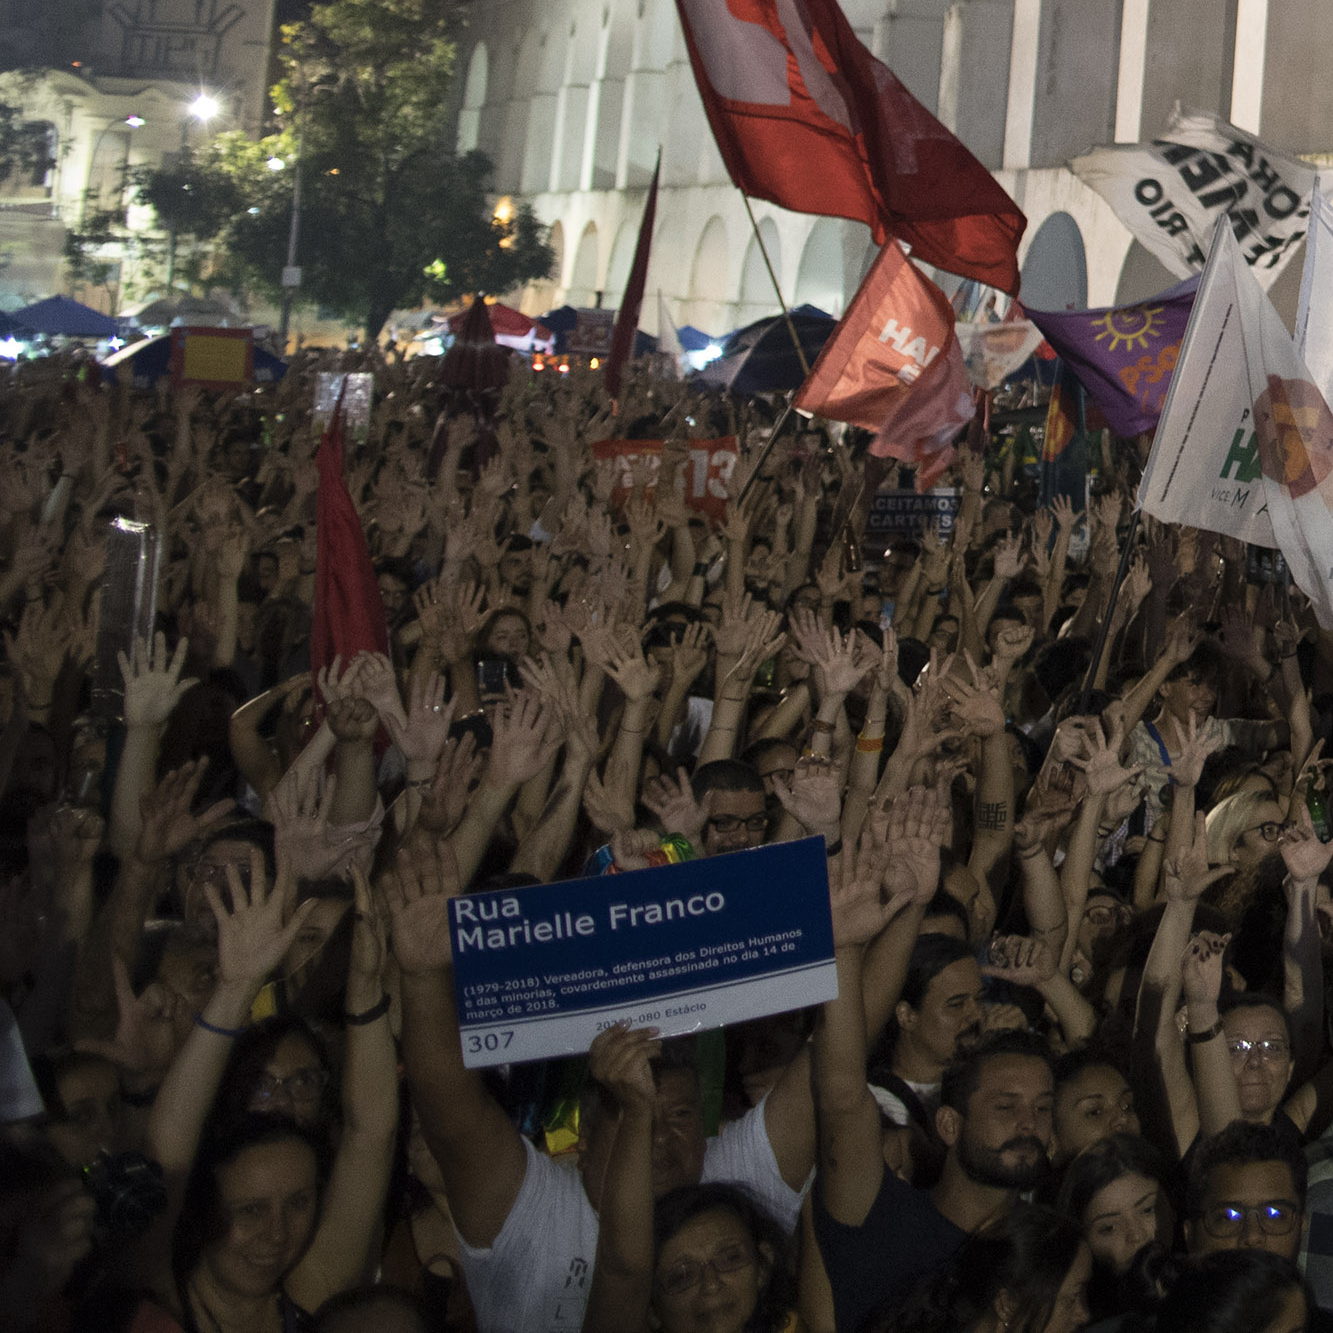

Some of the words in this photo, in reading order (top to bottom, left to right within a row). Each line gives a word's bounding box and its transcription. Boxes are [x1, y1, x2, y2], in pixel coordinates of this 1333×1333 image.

[1119, 338, 1183, 395] PSO
[689, 449, 738, 500] 13
[454, 897, 520, 924] Rua
[457, 911, 596, 953] Marielle
[609, 891, 726, 930] Franco
[464, 976, 541, 997] (1979-2018)
[544, 967, 609, 986] Vereadora,
[613, 956, 672, 974] defensora
[675, 949, 696, 963] dos
[700, 939, 745, 958] Direitos
[749, 928, 802, 948] Humanos
[465, 1000, 473, 1009] e
[476, 995, 498, 1008] das
[501, 989, 557, 1004] minorias,
[560, 971, 645, 996] covardemente
[648, 958, 720, 980] assassinada
[723, 954, 738, 964] no
[742, 947, 759, 961] dia
[763, 945, 777, 957] 14
[781, 941, 796, 952] de
[466, 1007, 504, 1020] março
[507, 1003, 522, 1015] de
[665, 1001, 707, 1018] Estácio
[468, 1031, 515, 1054] 307
